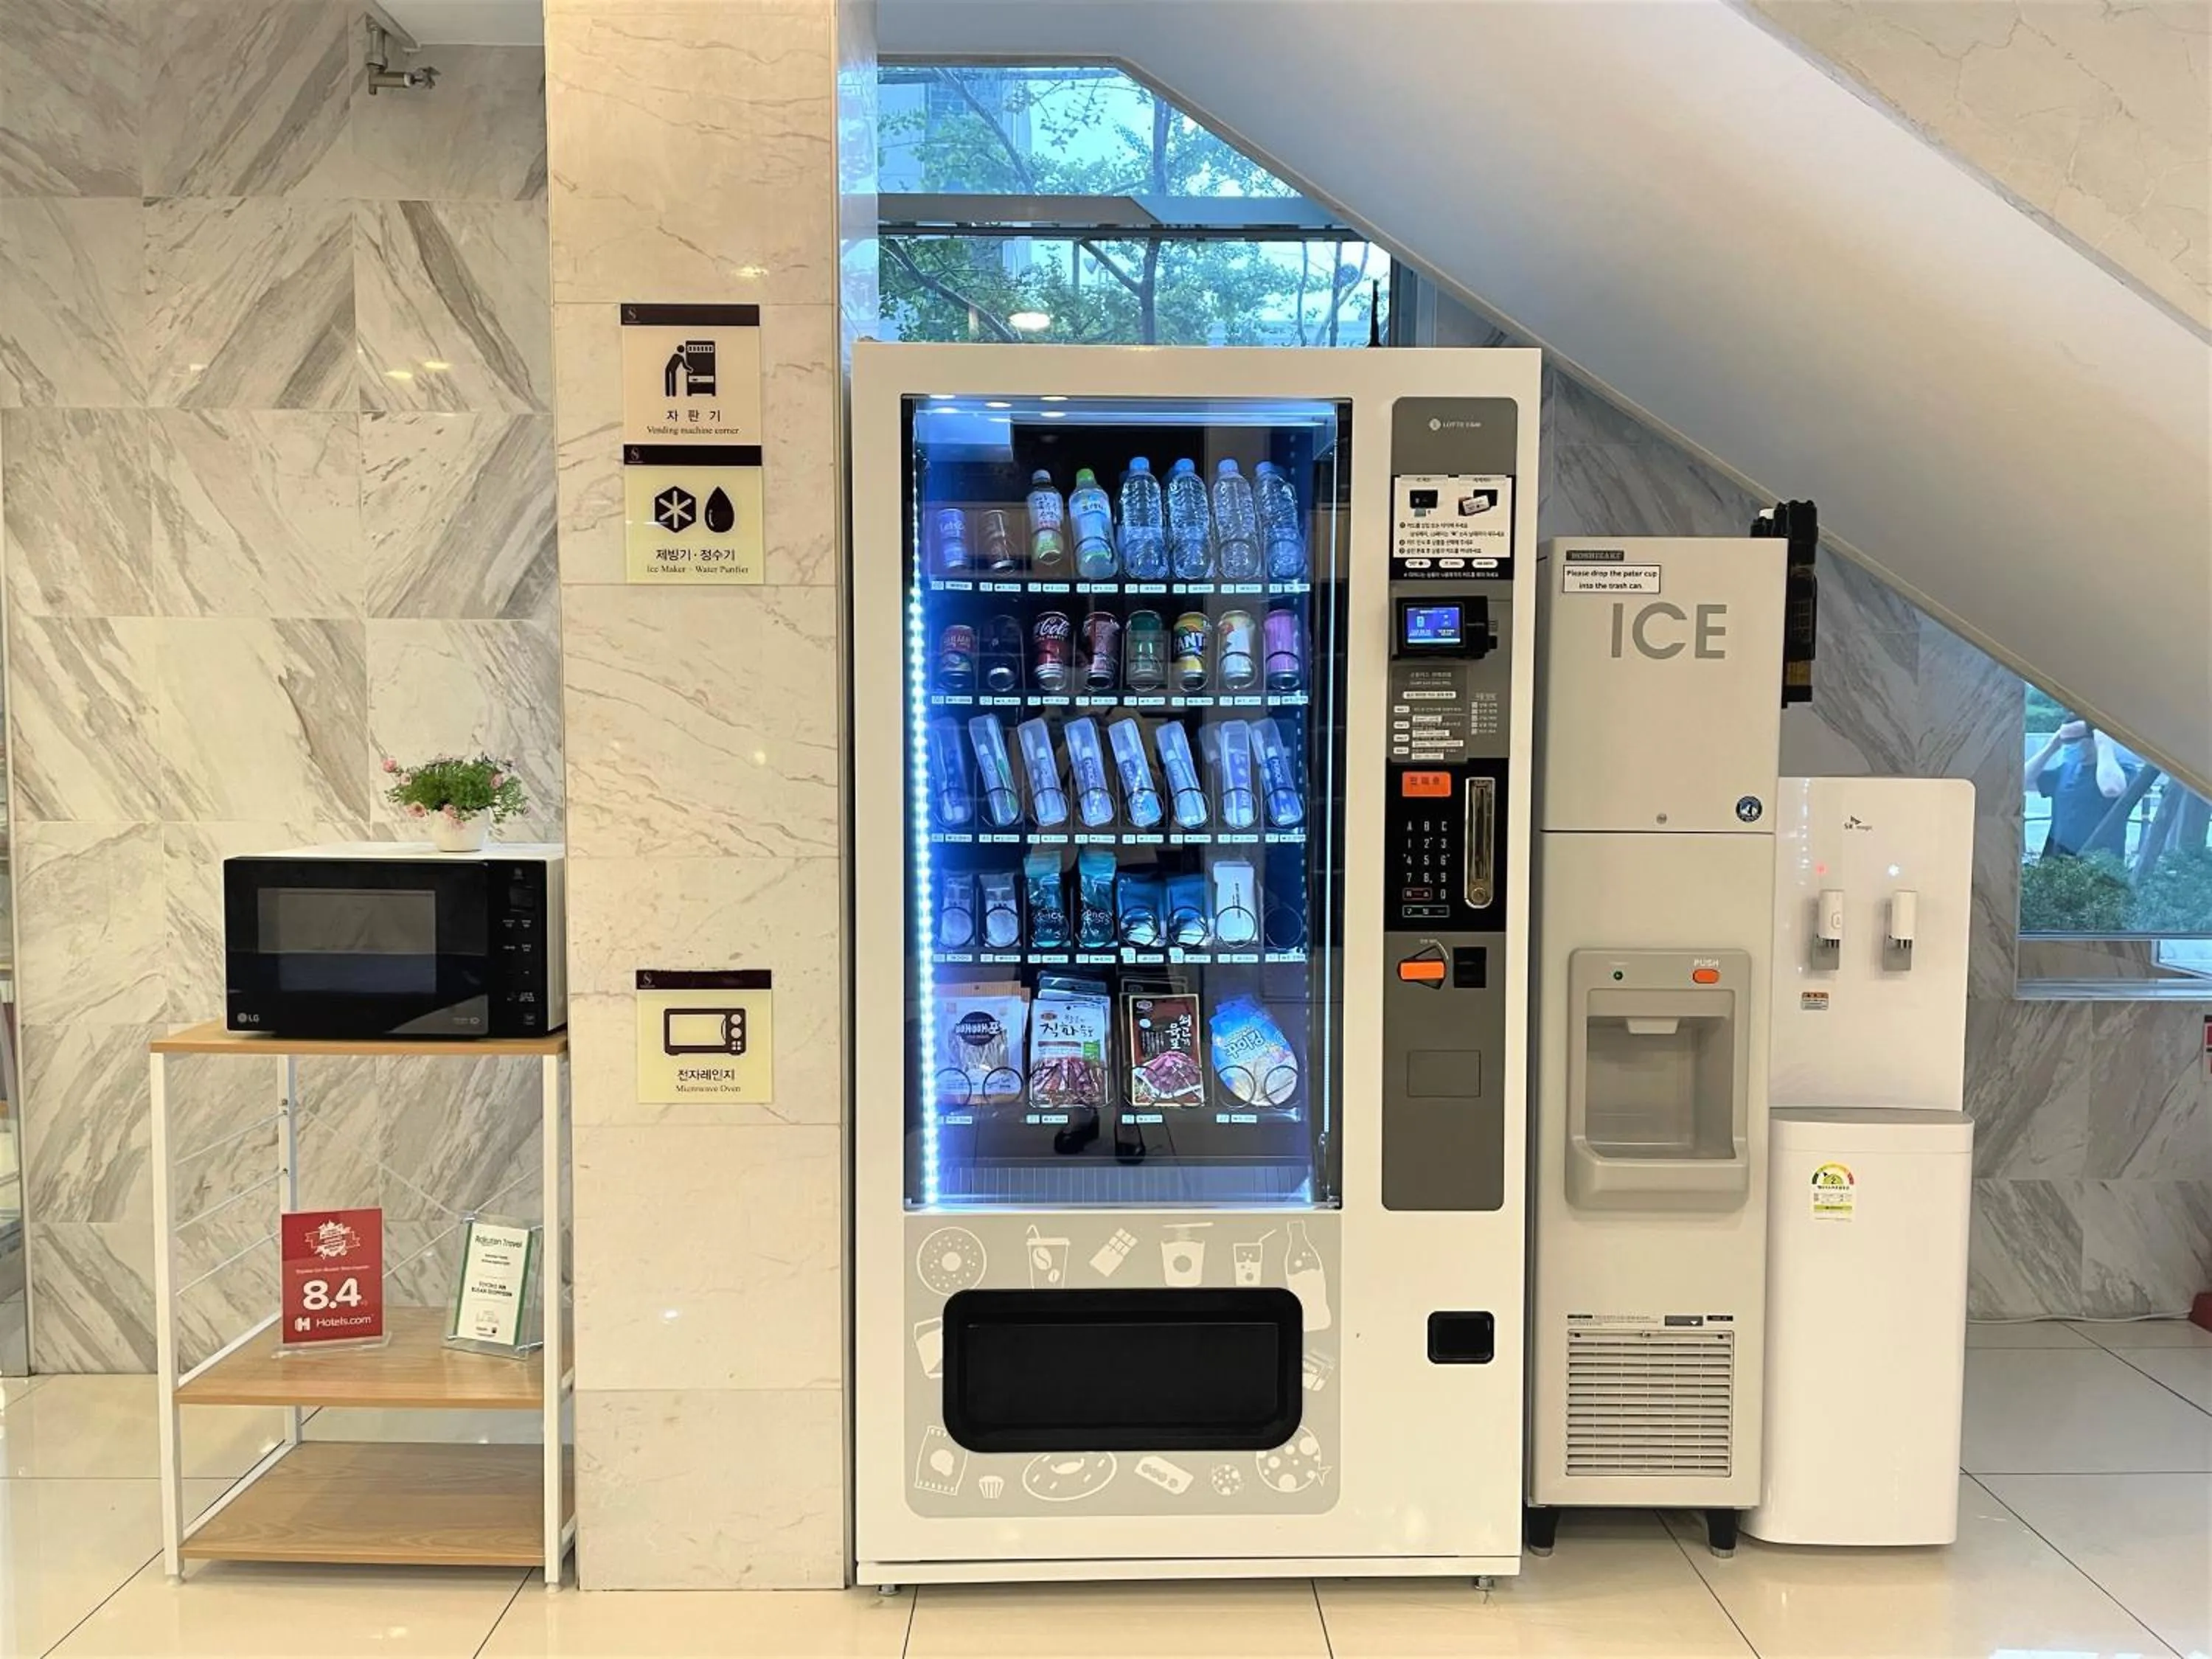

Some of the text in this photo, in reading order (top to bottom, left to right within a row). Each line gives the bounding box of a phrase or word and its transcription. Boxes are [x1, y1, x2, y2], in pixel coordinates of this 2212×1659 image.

[647, 425, 678, 436] Vending
[681, 425, 713, 434] machine
[1591, 570, 1608, 578] drop
[1611, 602, 1727, 659] ICE
[1694, 959, 1719, 967] PUSH
[248, 1014, 260, 1023] LG
[678, 1069, 735, 1081] 전자레인지
[676, 1085, 718, 1093] Microwave
[475, 1235, 522, 1248] Rakuten Travel
[303, 1278, 362, 1310] 8.4
[316, 1316, 372, 1327] Hotels.com
